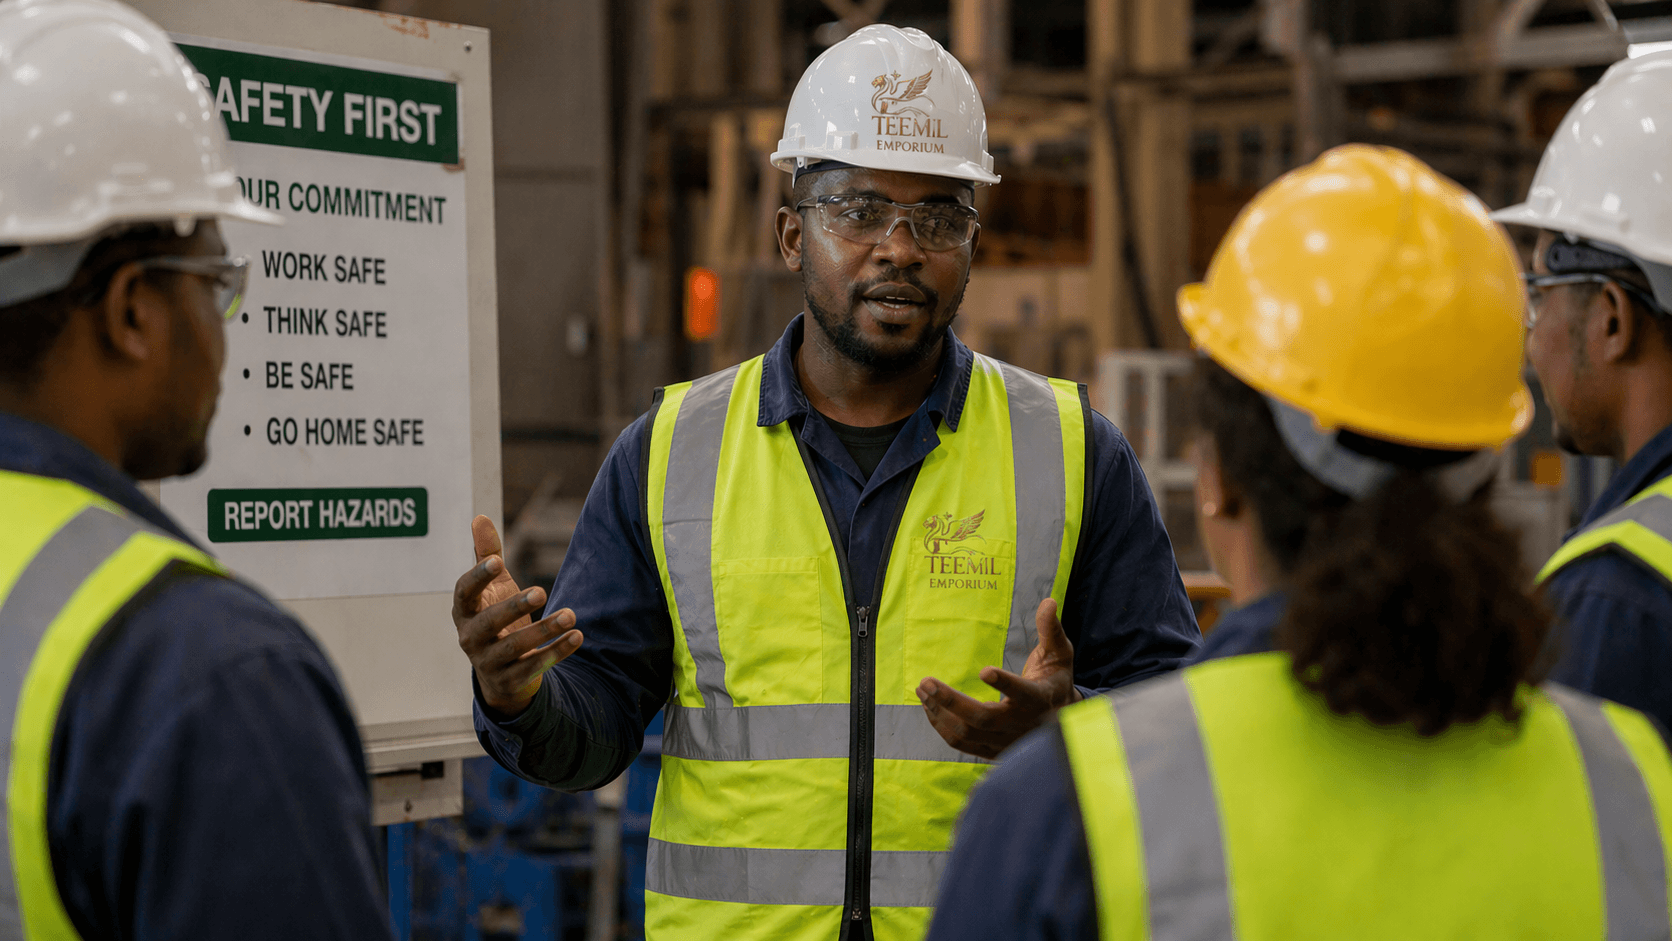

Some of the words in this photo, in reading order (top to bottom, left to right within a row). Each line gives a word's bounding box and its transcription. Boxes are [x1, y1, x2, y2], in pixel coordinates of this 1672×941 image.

[197, 73, 333, 132] AFETY
[344, 92, 442, 146] FIRST
[876, 139, 944, 153] EMPORIUM
[288, 182, 446, 225] COMMITMENT
[262, 250, 328, 282] WORK
[334, 255, 386, 285] SAFE
[263, 306, 329, 336] THINK
[335, 309, 387, 338] SAFE
[265, 361, 293, 389] BE
[300, 362, 354, 390] SAFE
[266, 417, 298, 446] GO
[305, 418, 366, 446] HOME
[373, 418, 424, 446] SAFE
[224, 500, 313, 530] REPORT
[319, 498, 416, 529] HAZARDS
[924, 555, 1001, 575] TEEMIL
[929, 578, 998, 590] EMPORIUM
